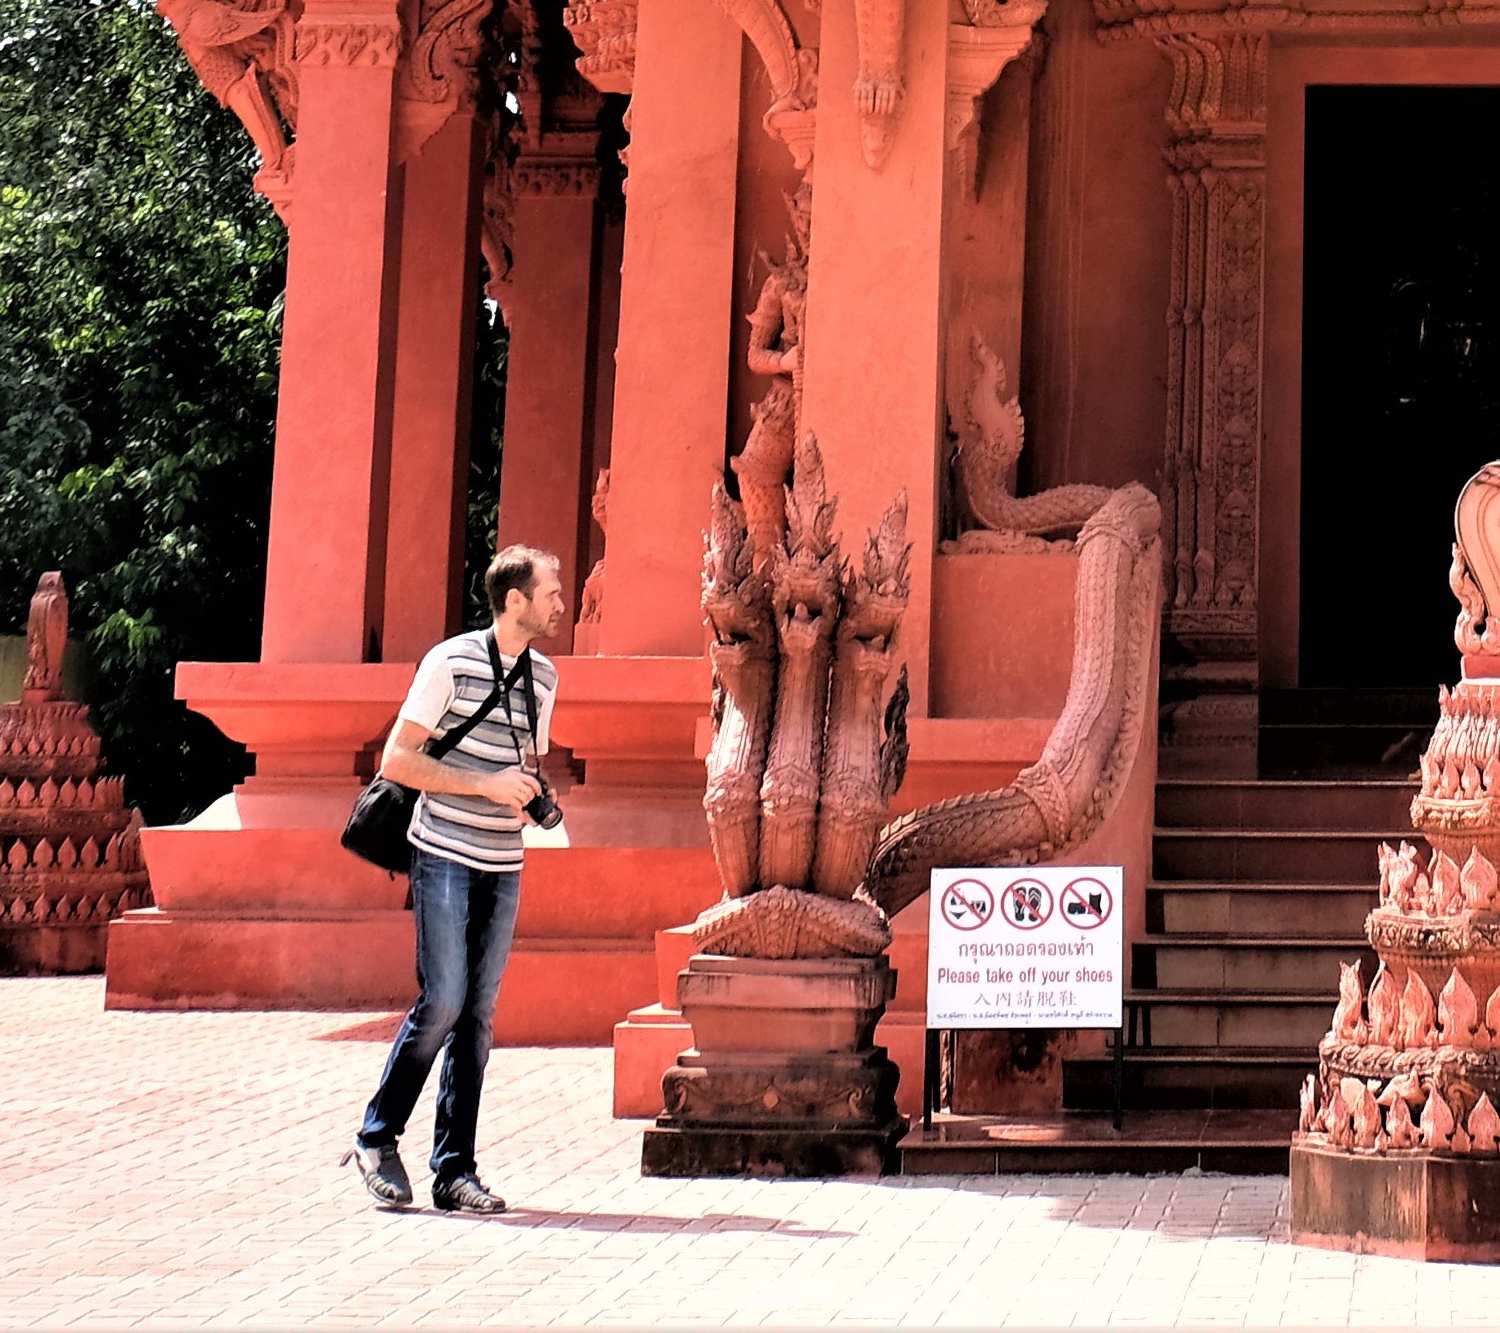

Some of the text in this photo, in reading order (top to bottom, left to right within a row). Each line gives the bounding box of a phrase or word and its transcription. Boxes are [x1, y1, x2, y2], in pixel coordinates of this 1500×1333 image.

[958, 935, 1094, 964] กรุณาถอดรองเท้า
[938, 966, 1113, 985] Please take off your shoes
